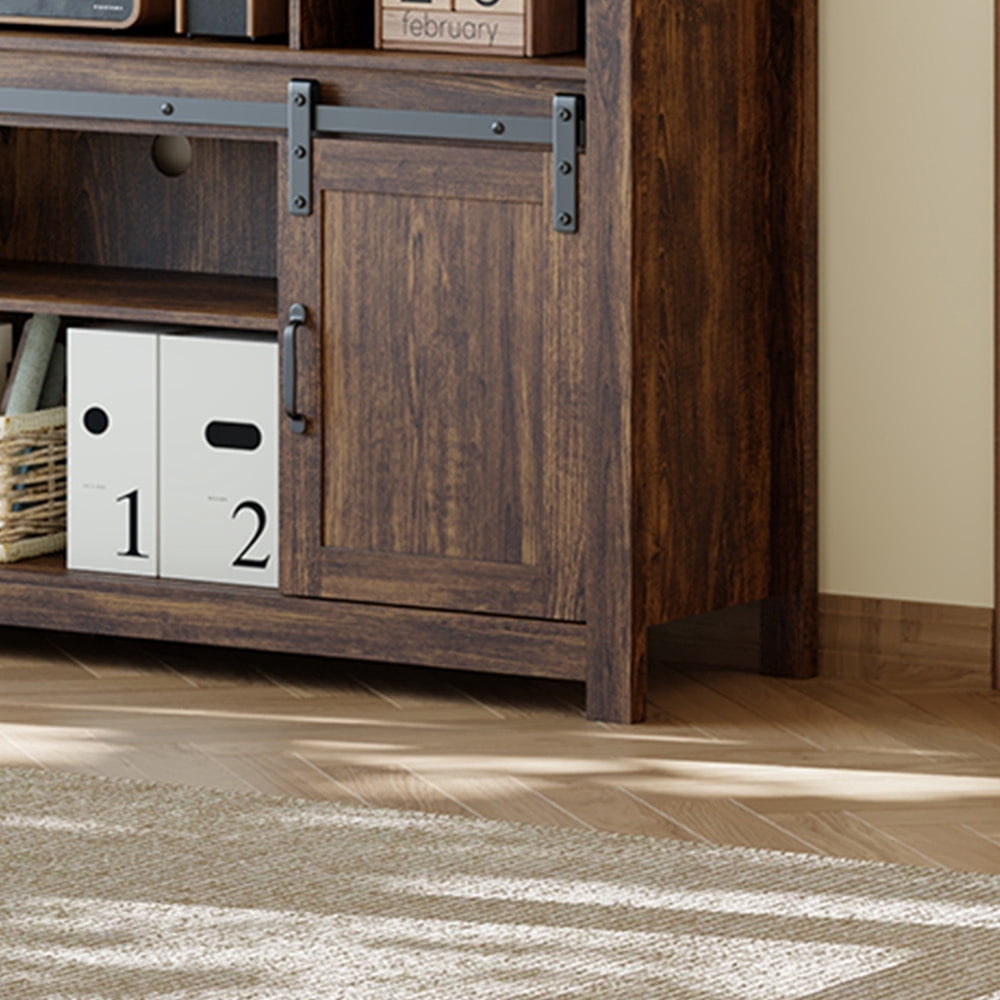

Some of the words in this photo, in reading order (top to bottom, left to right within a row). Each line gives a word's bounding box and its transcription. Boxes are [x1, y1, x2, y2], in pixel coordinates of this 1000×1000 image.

[402, 10, 499, 47] february
[115, 489, 149, 559] 1
[232, 500, 271, 569] 2
